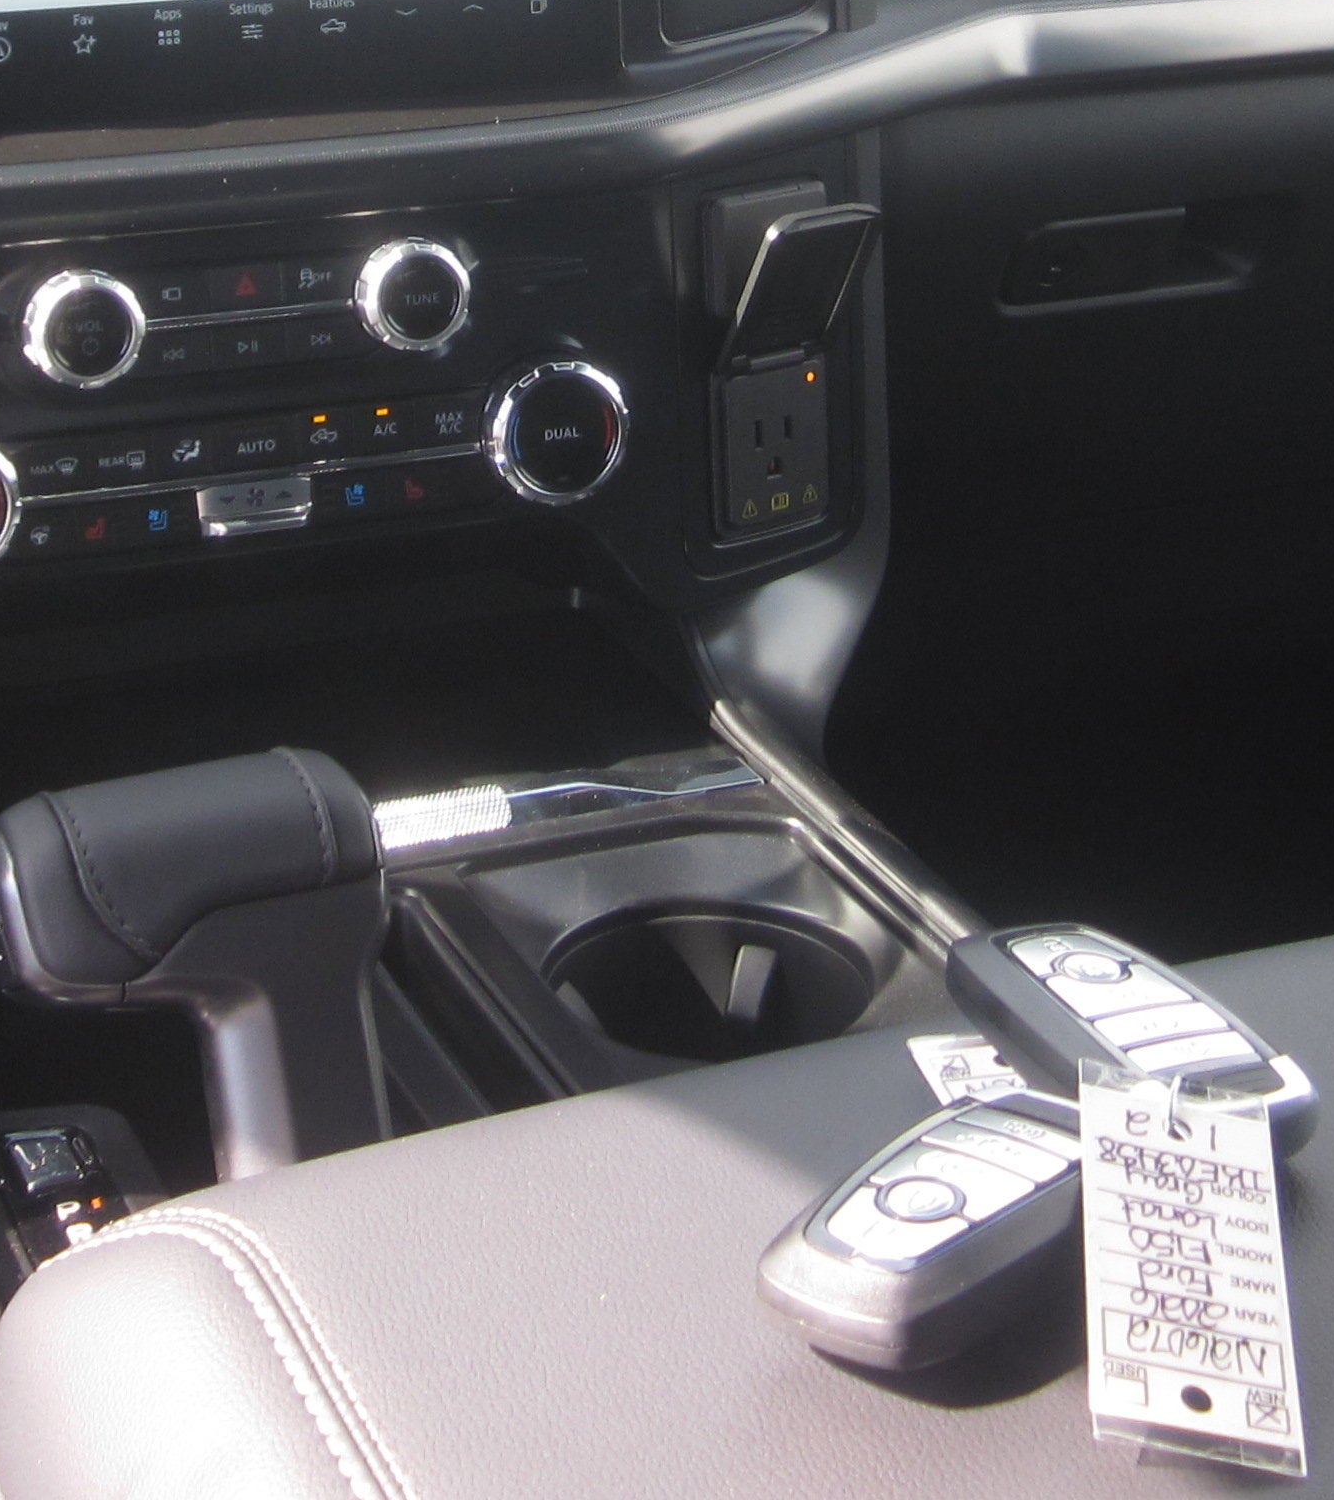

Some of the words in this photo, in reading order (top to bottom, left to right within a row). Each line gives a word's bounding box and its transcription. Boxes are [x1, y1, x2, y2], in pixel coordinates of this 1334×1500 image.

[153, 7, 183, 23] Apps
[228, 0, 275, 17] Settings
[72, 13, 95, 27] Fav
[313, 271, 332, 284] OFF
[403, 293, 441, 306] TUNE
[75, 320, 104, 333] VOL
[435, 412, 464, 424] MAX
[373, 422, 398, 437] A/C
[438, 421, 464, 435] A/C
[543, 427, 580, 442] DUAL
[236, 439, 276, 454] AUTO
[30, 463, 55, 476] MAX
[98, 455, 125, 468] REAR
[1209, 1181, 1268, 1206] COLOR
[55, 1200, 82, 1222] P
[1224, 1216, 1270, 1236] BODY
[1214, 1243, 1274, 1266] MODEL
[1138, 1259, 1213, 1296] Ford
[1229, 1274, 1277, 1295] MAKE
[1130, 1288, 1229, 1327] 2026
[1233, 1307, 1279, 1327] YEAR
[1103, 1359, 1147, 1379] USED
[1246, 1386, 1286, 1406] NEW
